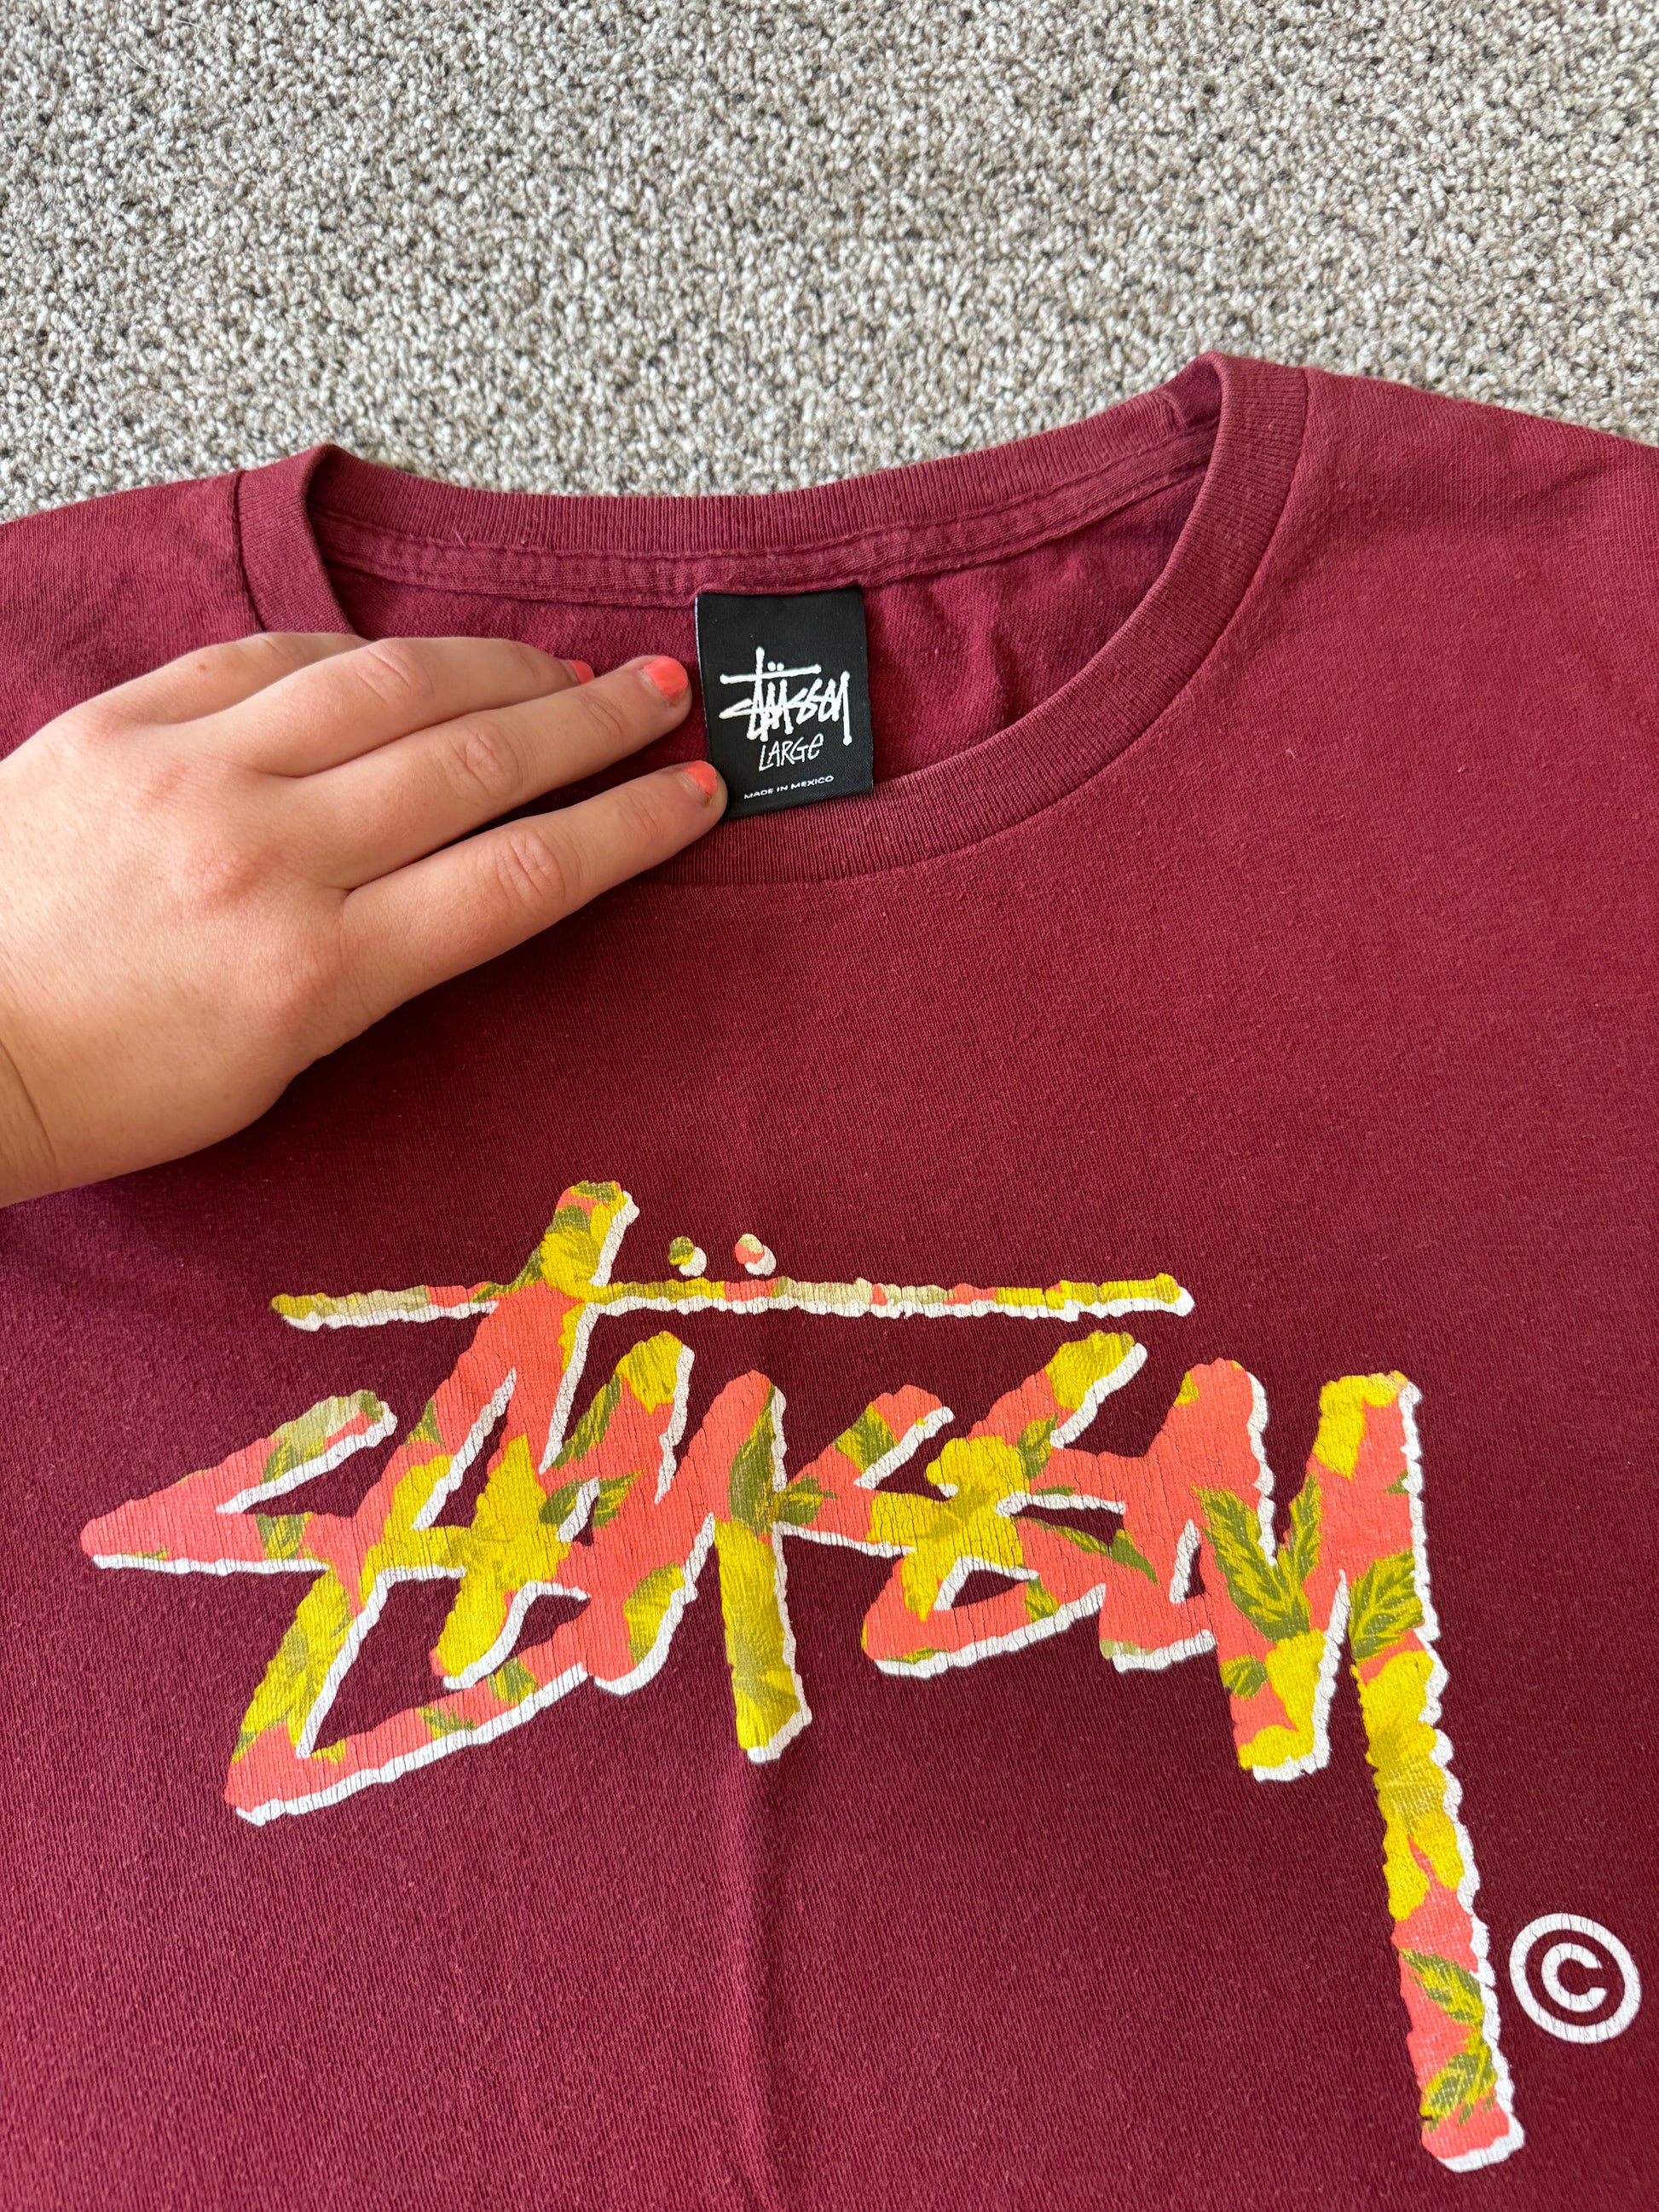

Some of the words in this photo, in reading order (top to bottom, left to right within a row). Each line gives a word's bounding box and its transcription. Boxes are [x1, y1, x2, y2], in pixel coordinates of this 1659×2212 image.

[743, 788, 773, 800] MADE
[777, 784, 789, 793] IN
[790, 775, 835, 790] MEXICO
